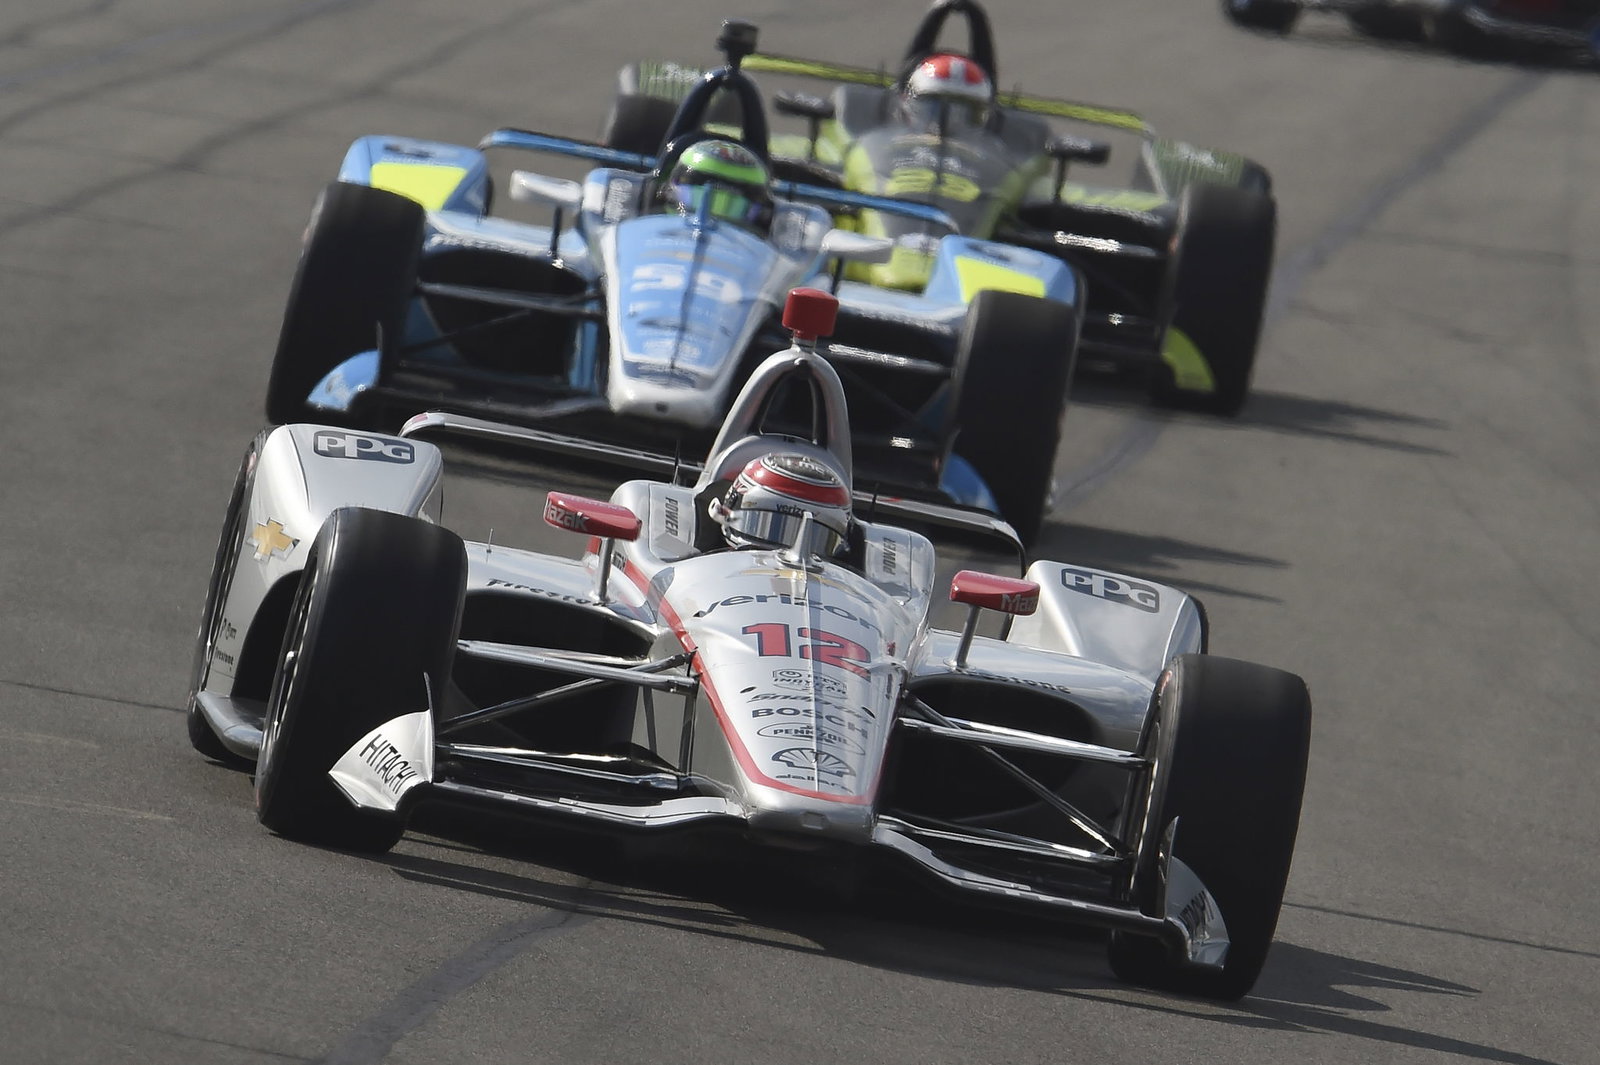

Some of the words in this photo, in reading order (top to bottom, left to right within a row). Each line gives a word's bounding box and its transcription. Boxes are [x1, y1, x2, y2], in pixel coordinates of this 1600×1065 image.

[631, 263, 743, 304] 59
[317, 434, 411, 460] PPG
[665, 497, 679, 537] POWER
[882, 537, 896, 576] POWER
[486, 579, 608, 607] Fireston
[1065, 572, 1156, 608] PPG
[693, 593, 883, 638] verizon
[741, 622, 872, 682] 12
[752, 707, 868, 739] BOSCH
[359, 733, 418, 795] HITACHI
